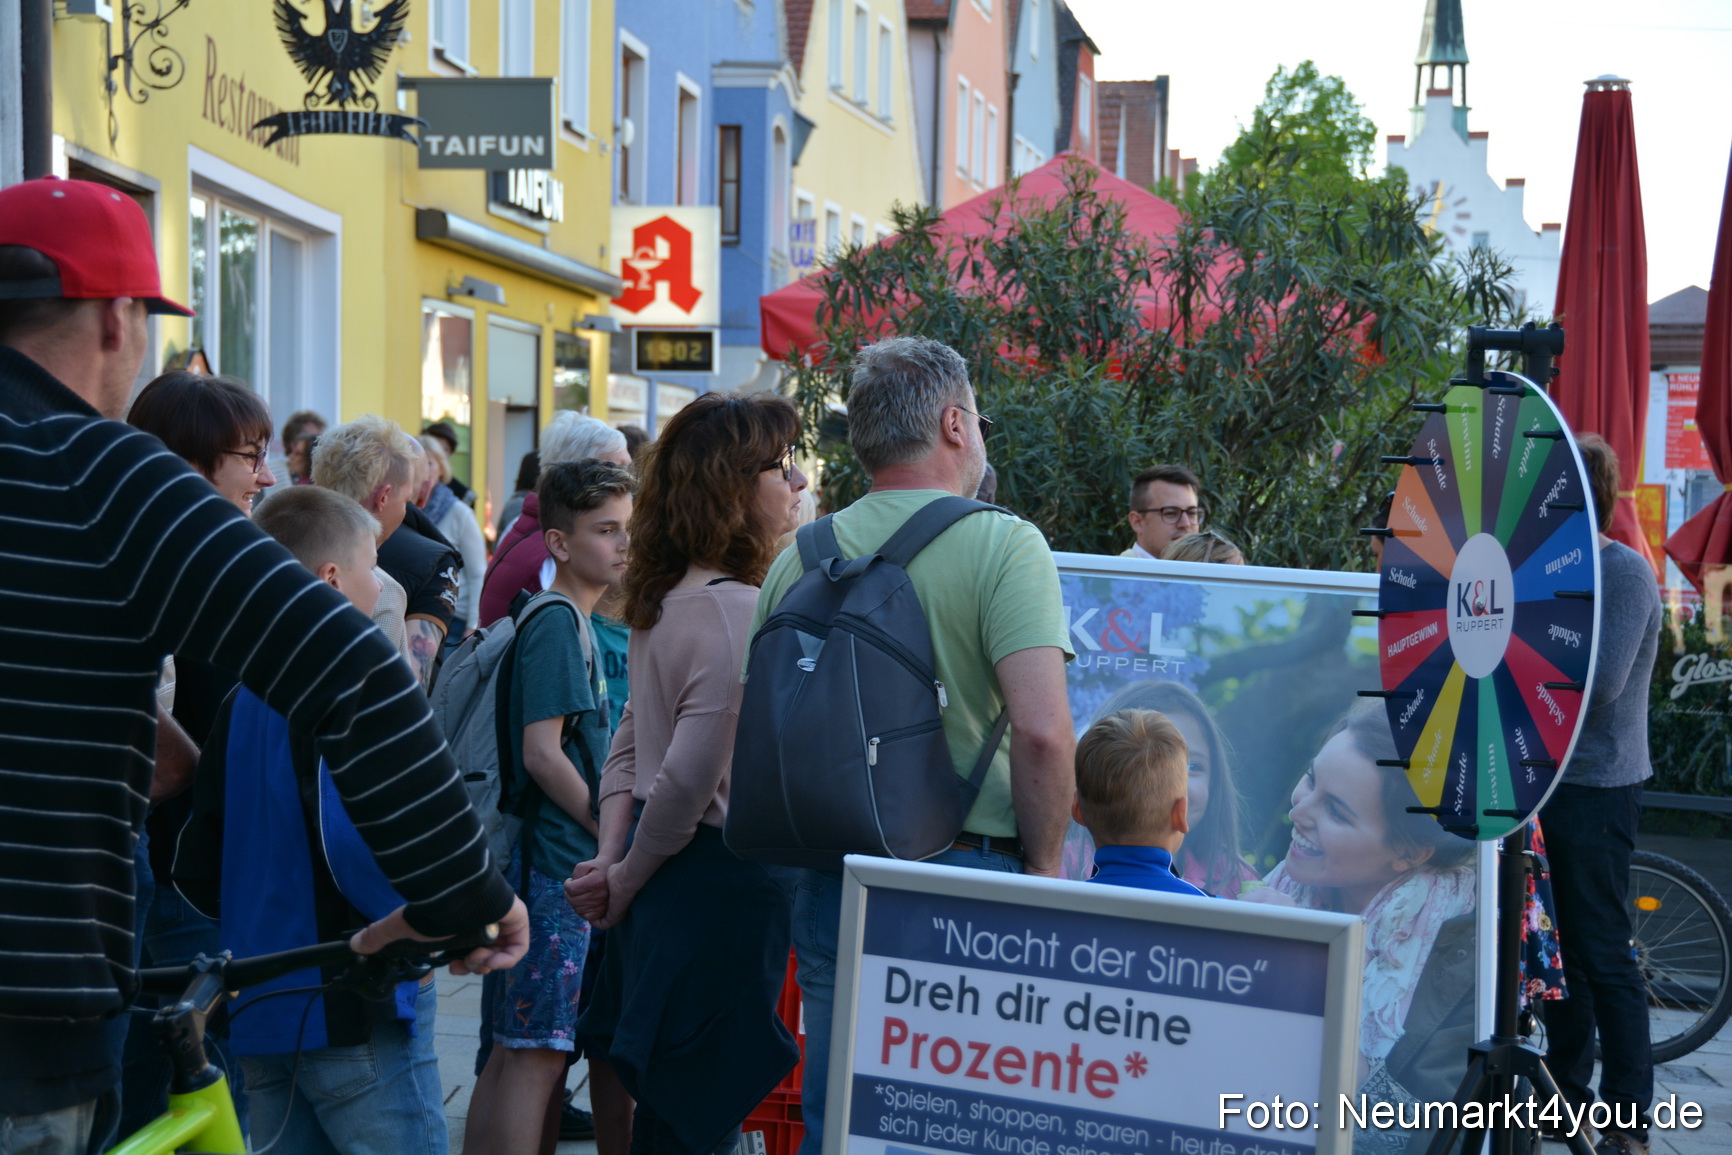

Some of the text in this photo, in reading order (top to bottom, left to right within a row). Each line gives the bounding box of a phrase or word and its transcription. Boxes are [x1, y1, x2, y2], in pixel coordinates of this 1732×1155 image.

[424, 135, 545, 156] TAIFUN
[1427, 438, 1447, 490] Schade
[1402, 496, 1427, 534] Schade
[1388, 566, 1417, 589] Schade
[1545, 548, 1582, 575] Gewinn
[1456, 579, 1504, 618] K&L
[1387, 621, 1438, 658] HAUPTGEWINN
[1456, 618, 1504, 633] RUPPERT
[1548, 623, 1581, 648] Schade
[1065, 654, 1186, 674] UPPERT
[1670, 652, 1732, 699] Glos
[1400, 688, 1424, 729] Schade
[1535, 682, 1566, 726] Schade
[1454, 752, 1468, 816] Schade
[1070, 938, 1136, 979] der
[884, 966, 1191, 1046] Dreh dir deine
[879, 1112, 918, 1137] sich
[923, 1118, 978, 1146] jeder
[983, 1127, 1050, 1155] Kunde
[969, 1100, 1067, 1135] shoppen,
[1075, 1119, 1149, 1147] sparen
